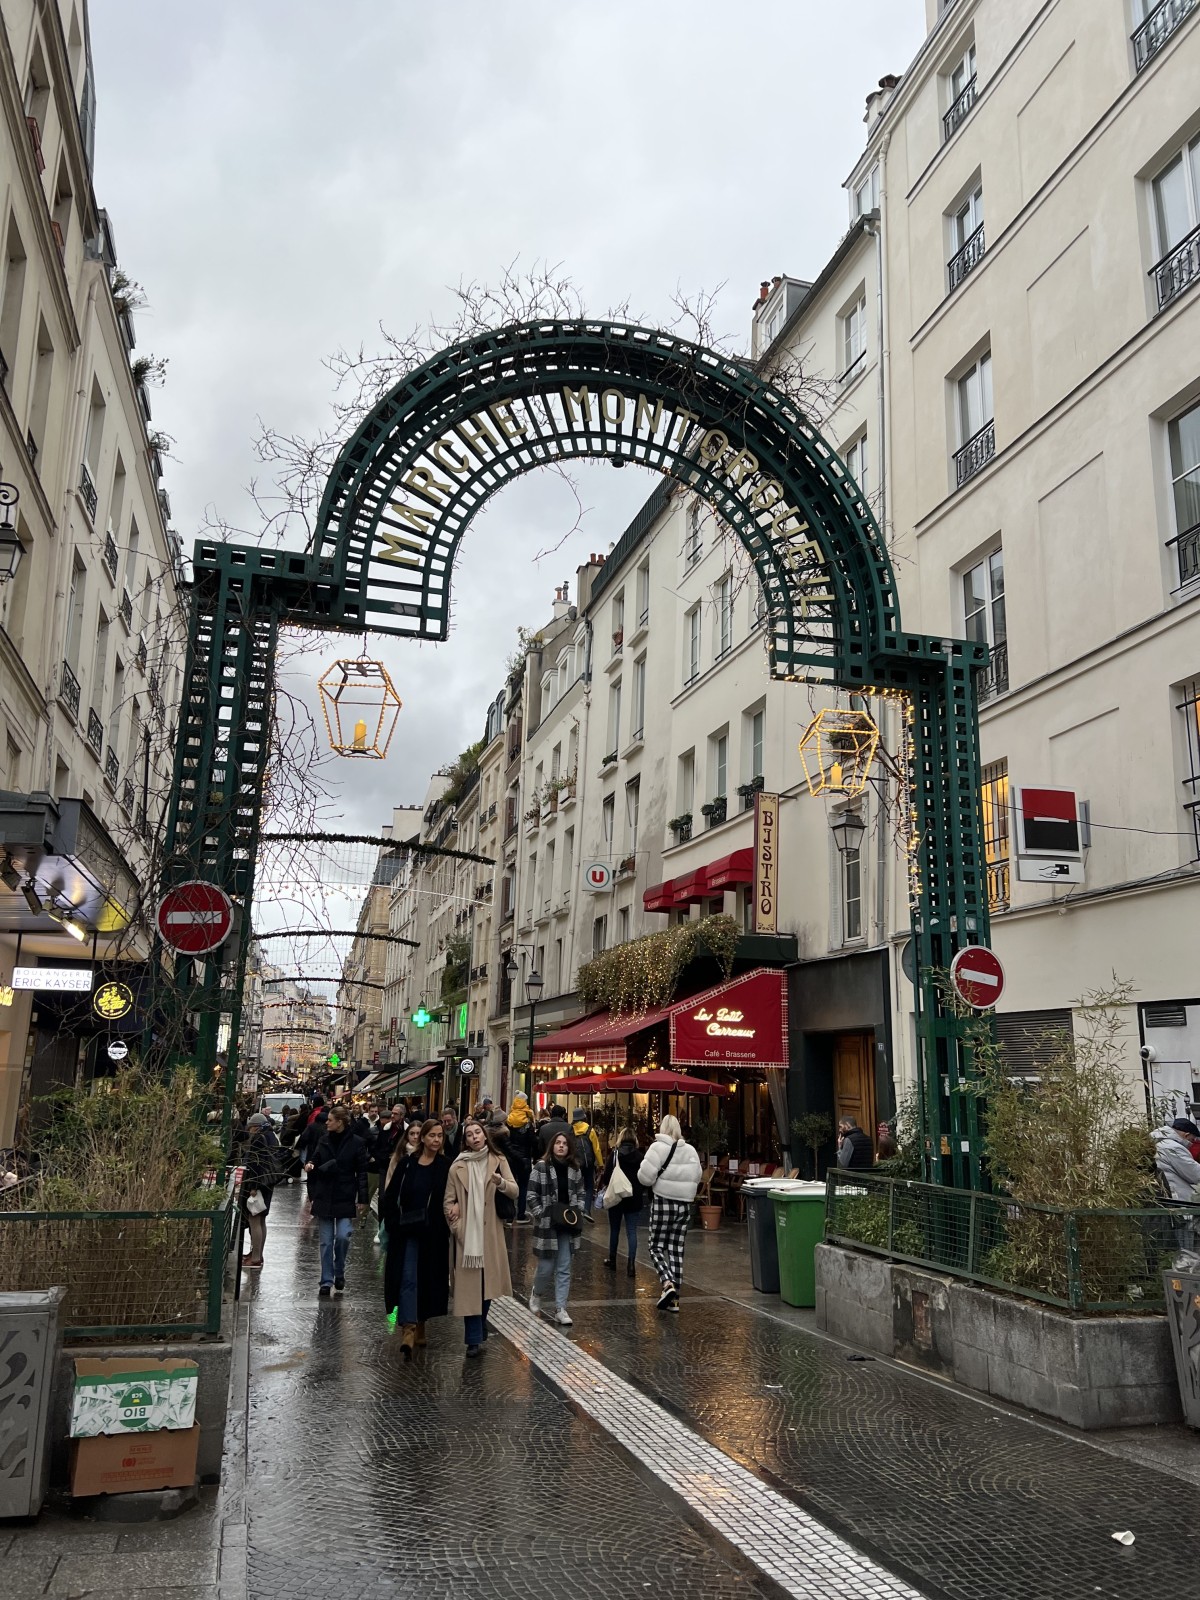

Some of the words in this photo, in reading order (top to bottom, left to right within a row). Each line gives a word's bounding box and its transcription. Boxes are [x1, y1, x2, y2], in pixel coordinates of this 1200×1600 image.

[378, 397, 528, 566] MARCHE
[562, 385, 836, 618] MONTORGUEIL
[760, 811, 774, 915] BISTRO
[591, 871, 604, 883] U
[16, 969, 92, 979] BOULANGERIE
[14, 977, 41, 988] ERIC
[45, 979, 91, 989] KAYSER
[693, 1007, 714, 1021] Les
[716, 1007, 744, 1022] Petits
[706, 1022, 756, 1038] Carreaux
[725, 1050, 756, 1058] Brasserie
[123, 1407, 146, 1418] BIO
